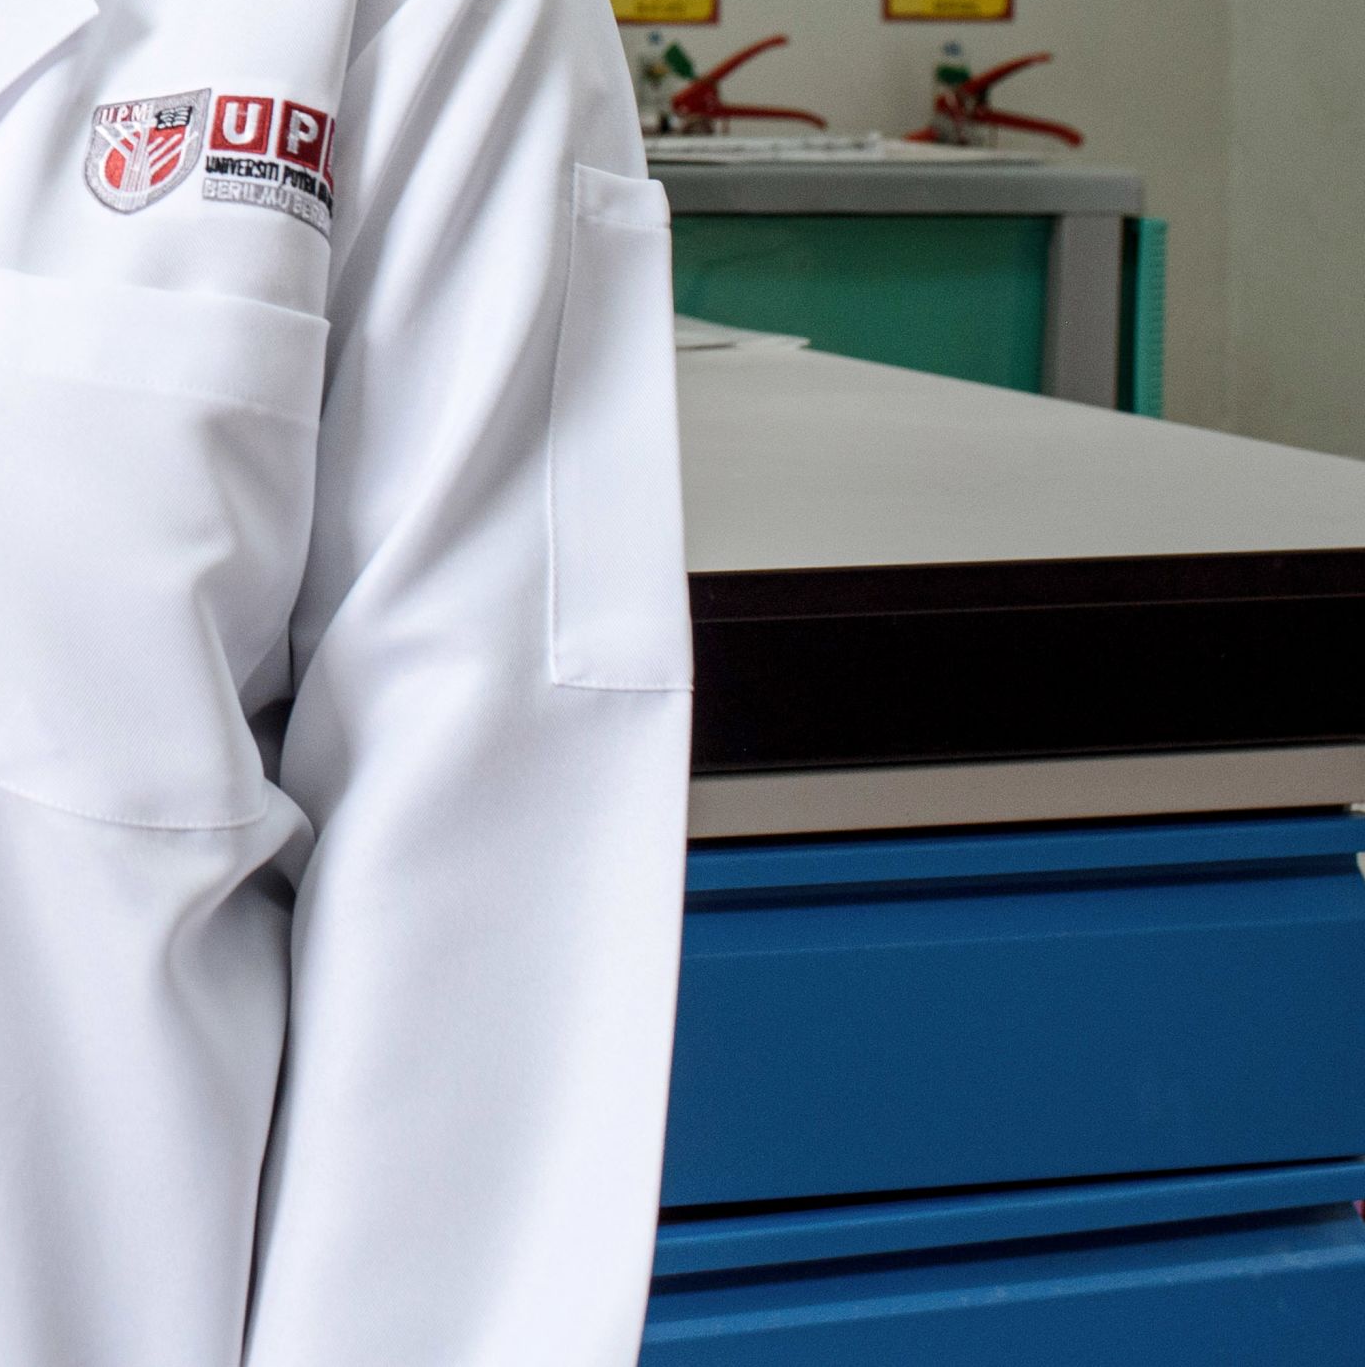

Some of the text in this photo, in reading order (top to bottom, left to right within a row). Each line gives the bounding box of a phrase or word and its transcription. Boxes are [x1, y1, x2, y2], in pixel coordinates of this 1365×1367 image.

[99, 103, 154, 126] UPM
[214, 98, 331, 159] UP
[205, 154, 280, 182] UNIVERSITI
